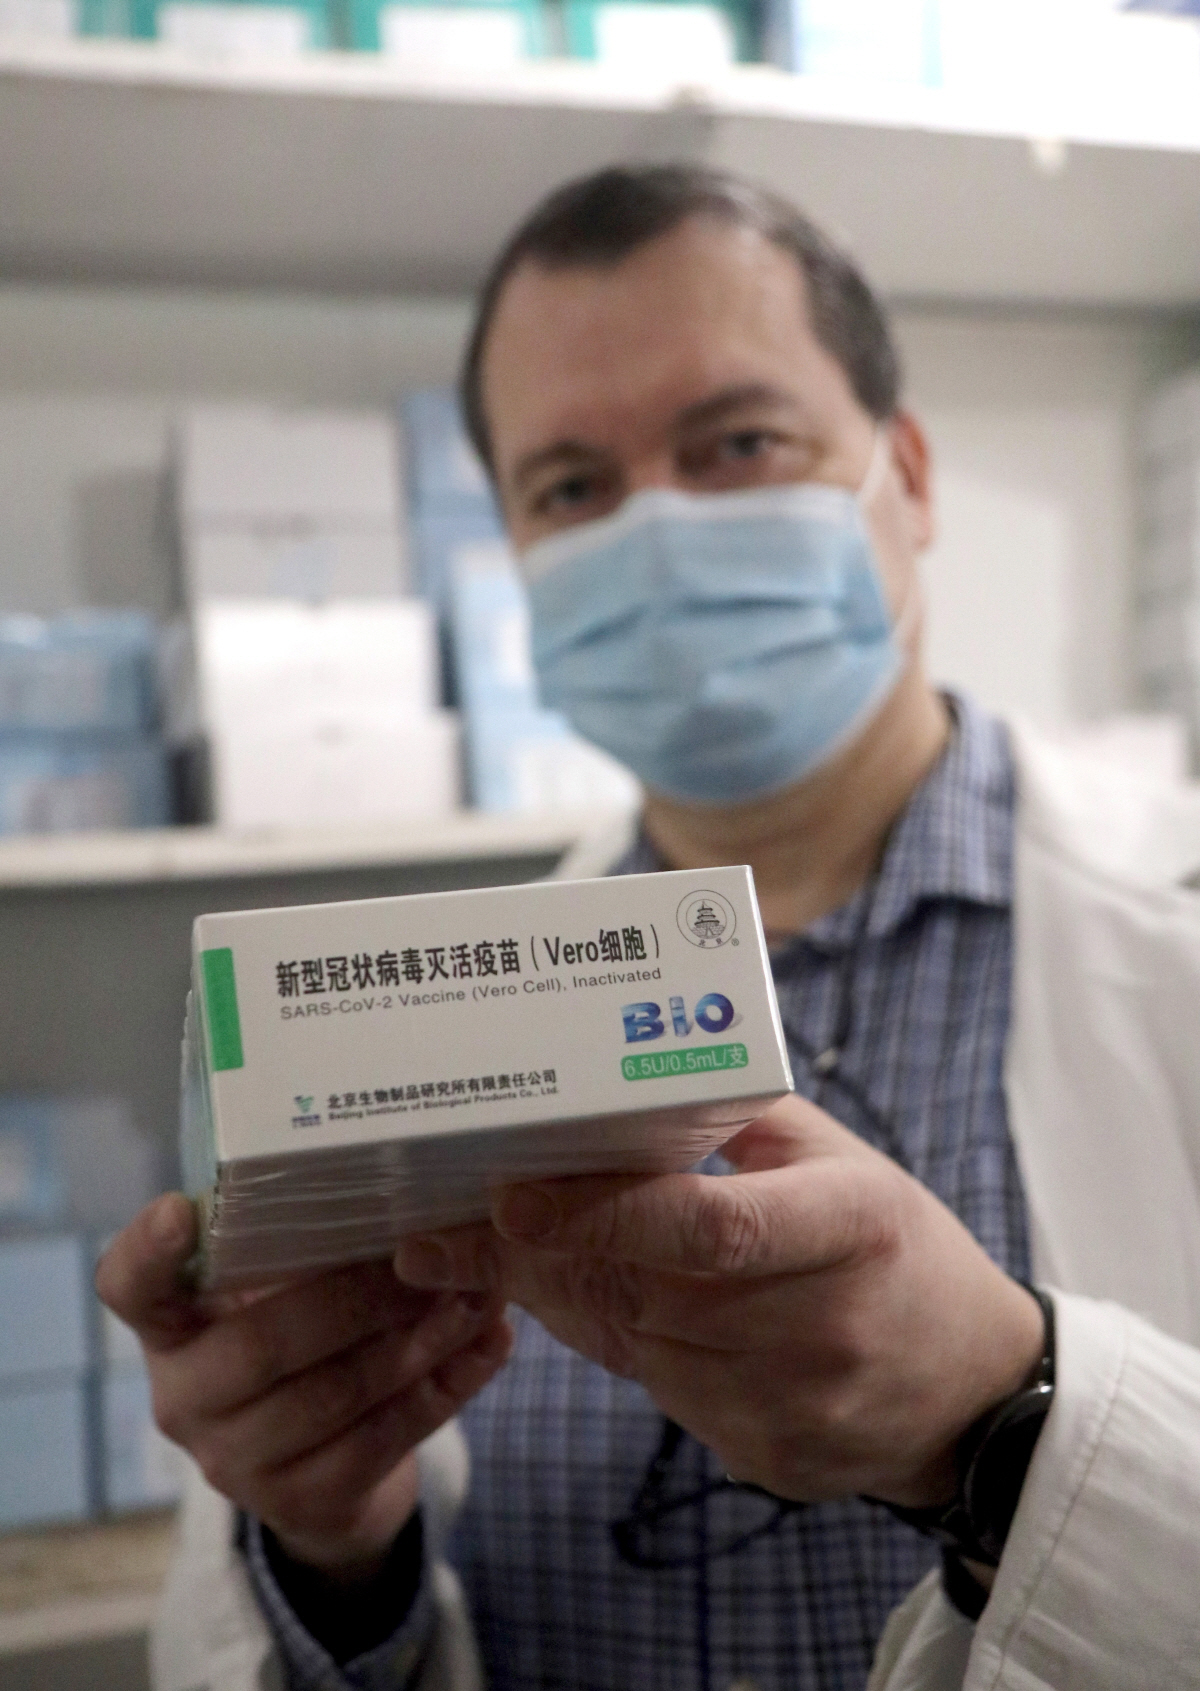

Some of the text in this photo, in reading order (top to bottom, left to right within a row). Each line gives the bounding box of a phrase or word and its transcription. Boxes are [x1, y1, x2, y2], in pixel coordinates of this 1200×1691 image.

[280, 968, 661, 1020] SARS-CoV-2 Vaccine (Vero Cell), Inactivated
[624, 1046, 746, 1077] 6.5U/0.5mL/支
